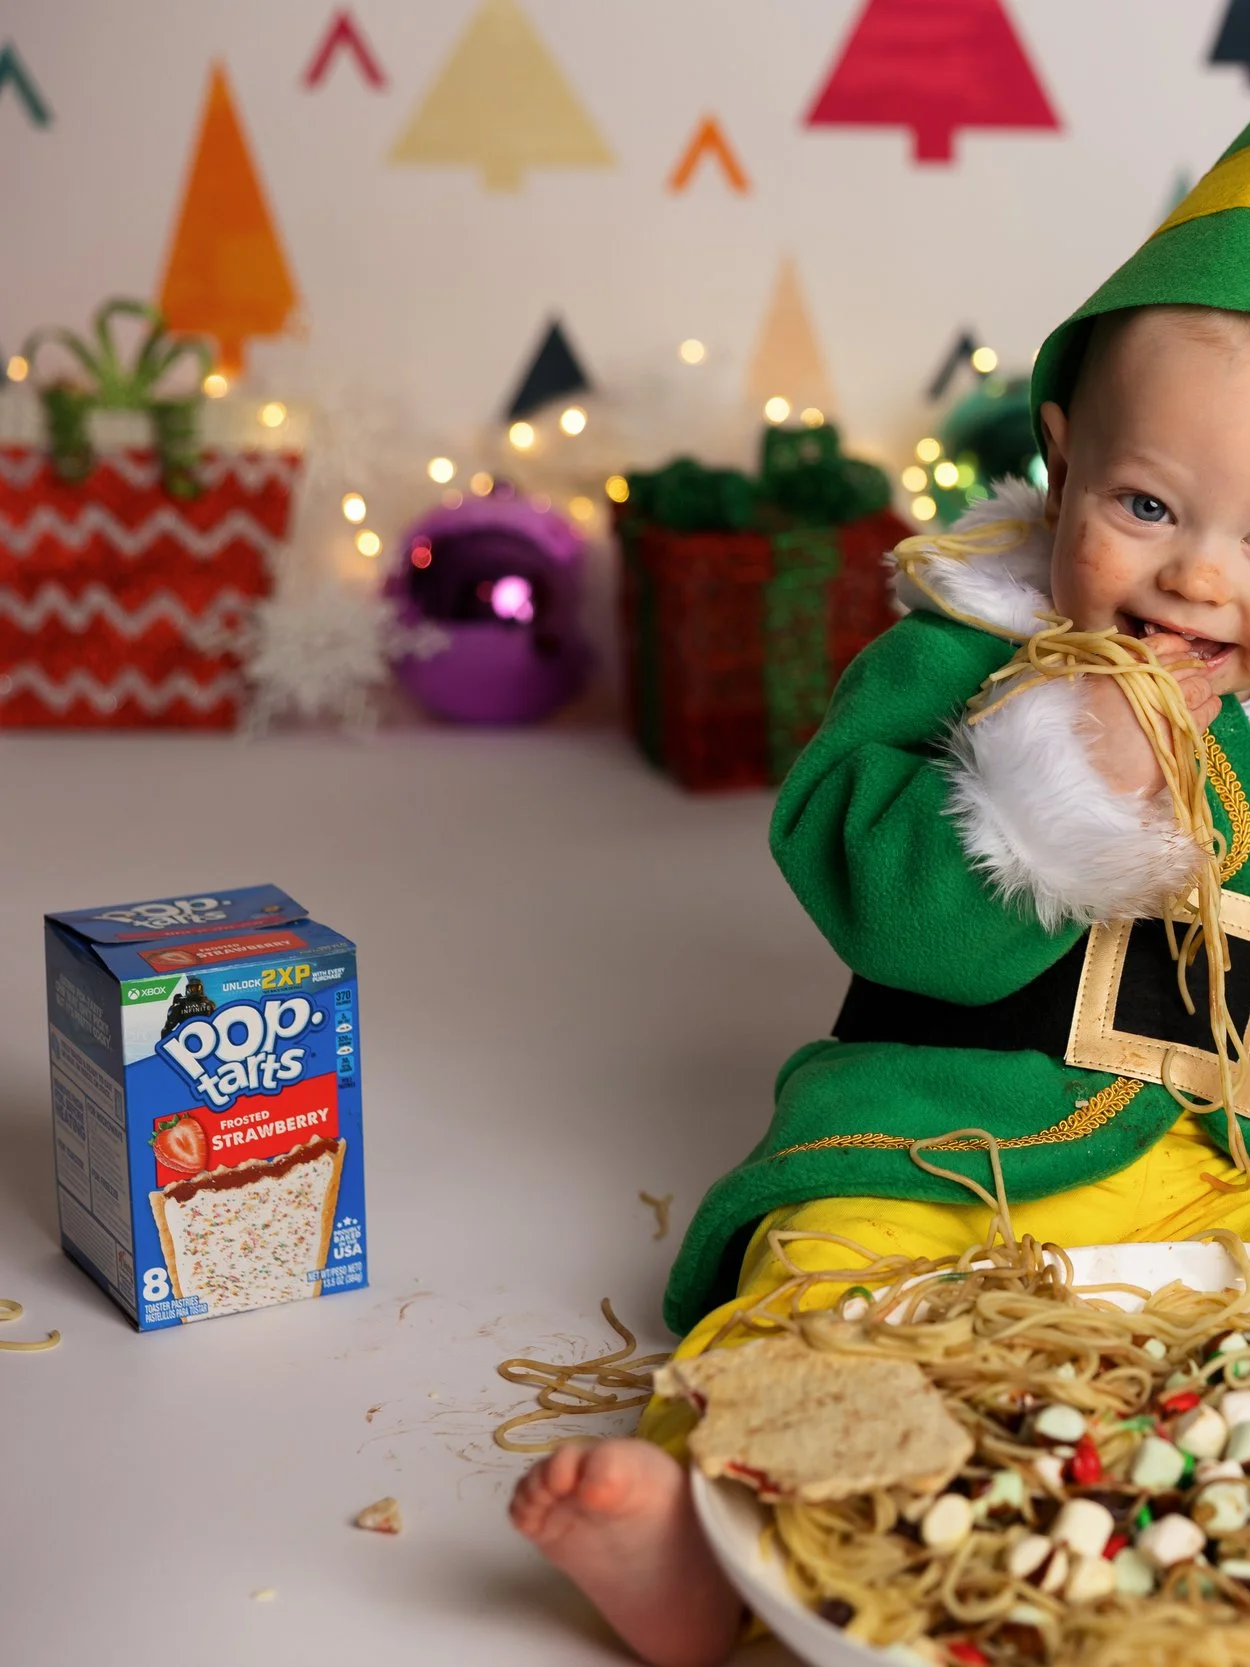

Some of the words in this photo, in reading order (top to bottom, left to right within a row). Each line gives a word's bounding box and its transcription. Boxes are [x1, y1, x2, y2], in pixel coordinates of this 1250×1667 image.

[196, 940, 291, 959] STRAWBERRY
[223, 979, 261, 991] UNLOCK
[262, 964, 310, 989] 2XP
[327, 967, 345, 976] EVERY
[141, 986, 166, 997] XBOX
[336, 990, 350, 1001] 370
[181, 1005, 210, 1014] INFINITE
[211, 1107, 329, 1151] STRAWBERRY
[220, 1110, 270, 1130] FROSTED
[333, 1243, 362, 1259] USA
[142, 1267, 170, 1302] 8
[145, 1301, 170, 1314] TOASTER
[171, 1296, 199, 1309] PASTRIES
